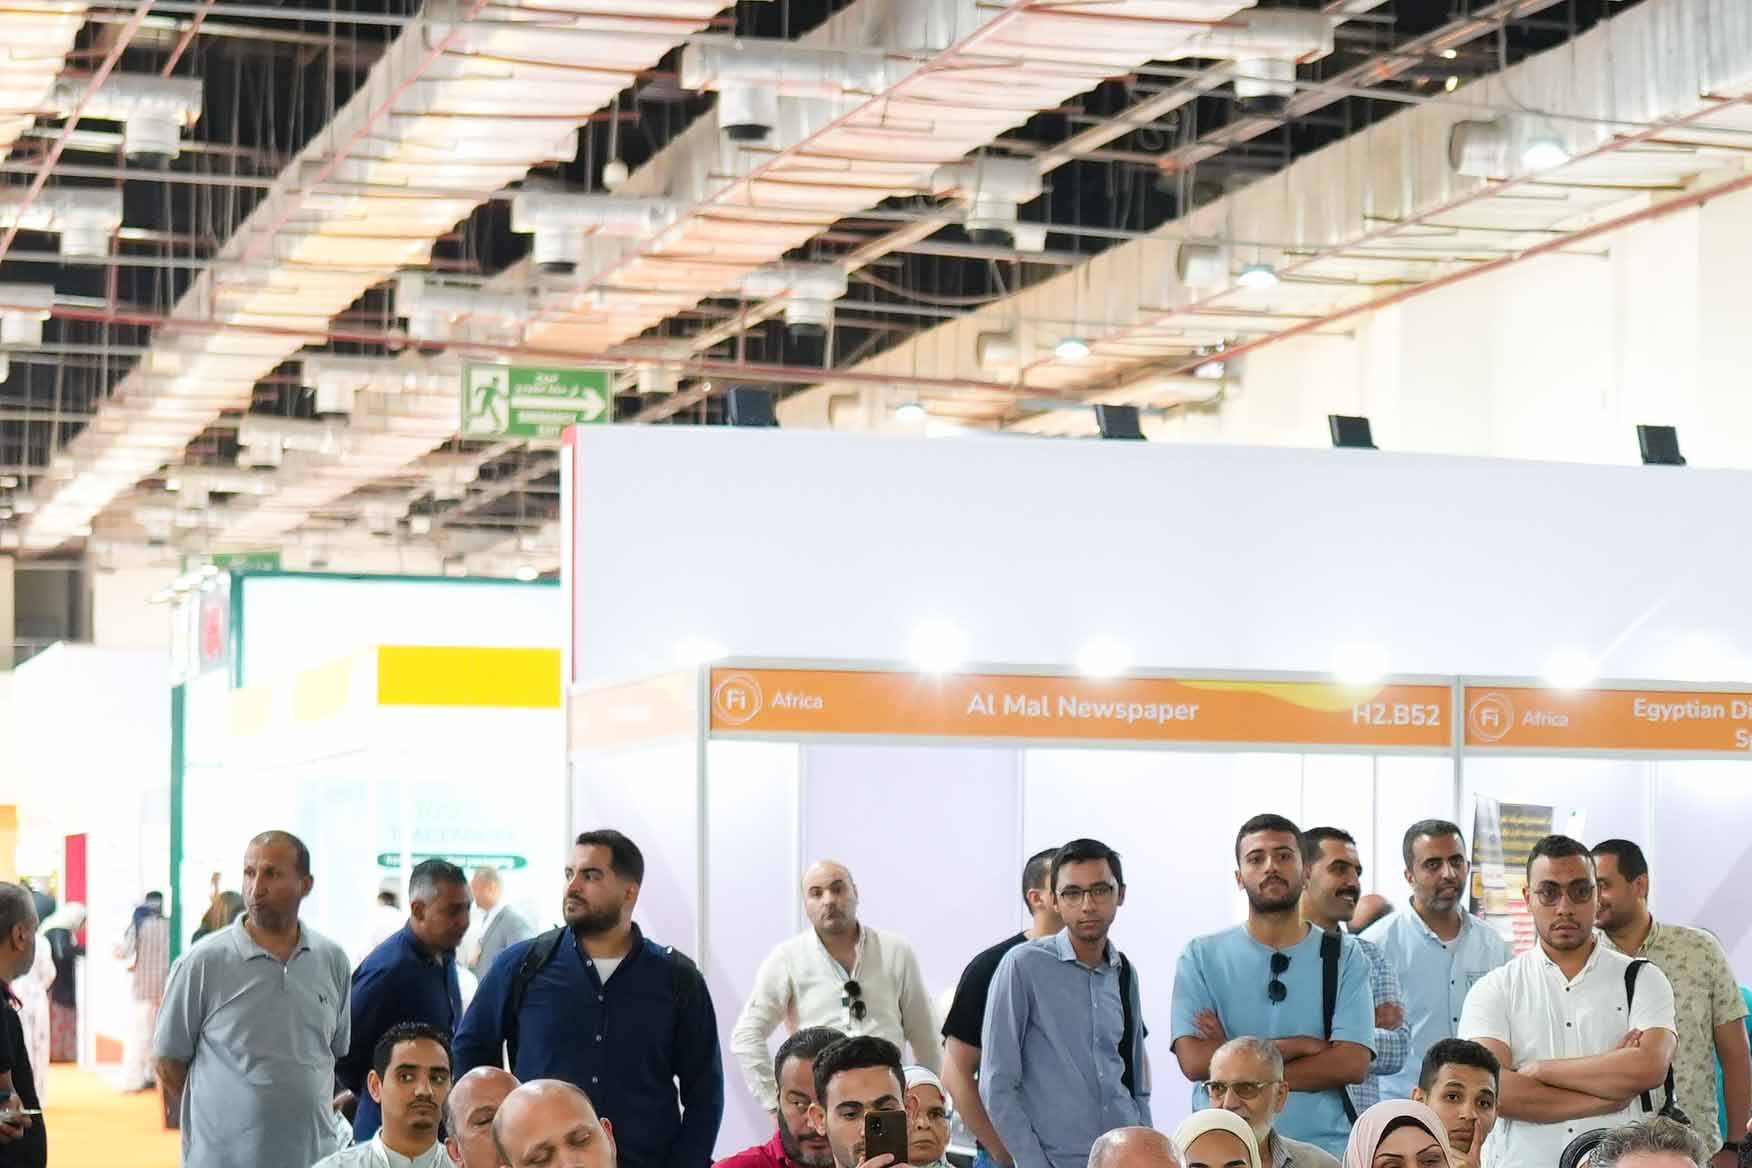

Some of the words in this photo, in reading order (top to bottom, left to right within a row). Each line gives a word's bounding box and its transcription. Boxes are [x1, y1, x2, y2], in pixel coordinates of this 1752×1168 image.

[726, 687, 748, 711] Fi
[769, 690, 826, 710] Africa
[967, 692, 997, 716] Al
[1003, 693, 1050, 718] Mal
[1058, 695, 1200, 725] Newspaper
[1633, 698, 1726, 722] Egyptian
[1352, 703, 1441, 727] H2.B52
[1481, 708, 1500, 727] Fi
[1521, 710, 1570, 728] Africa
